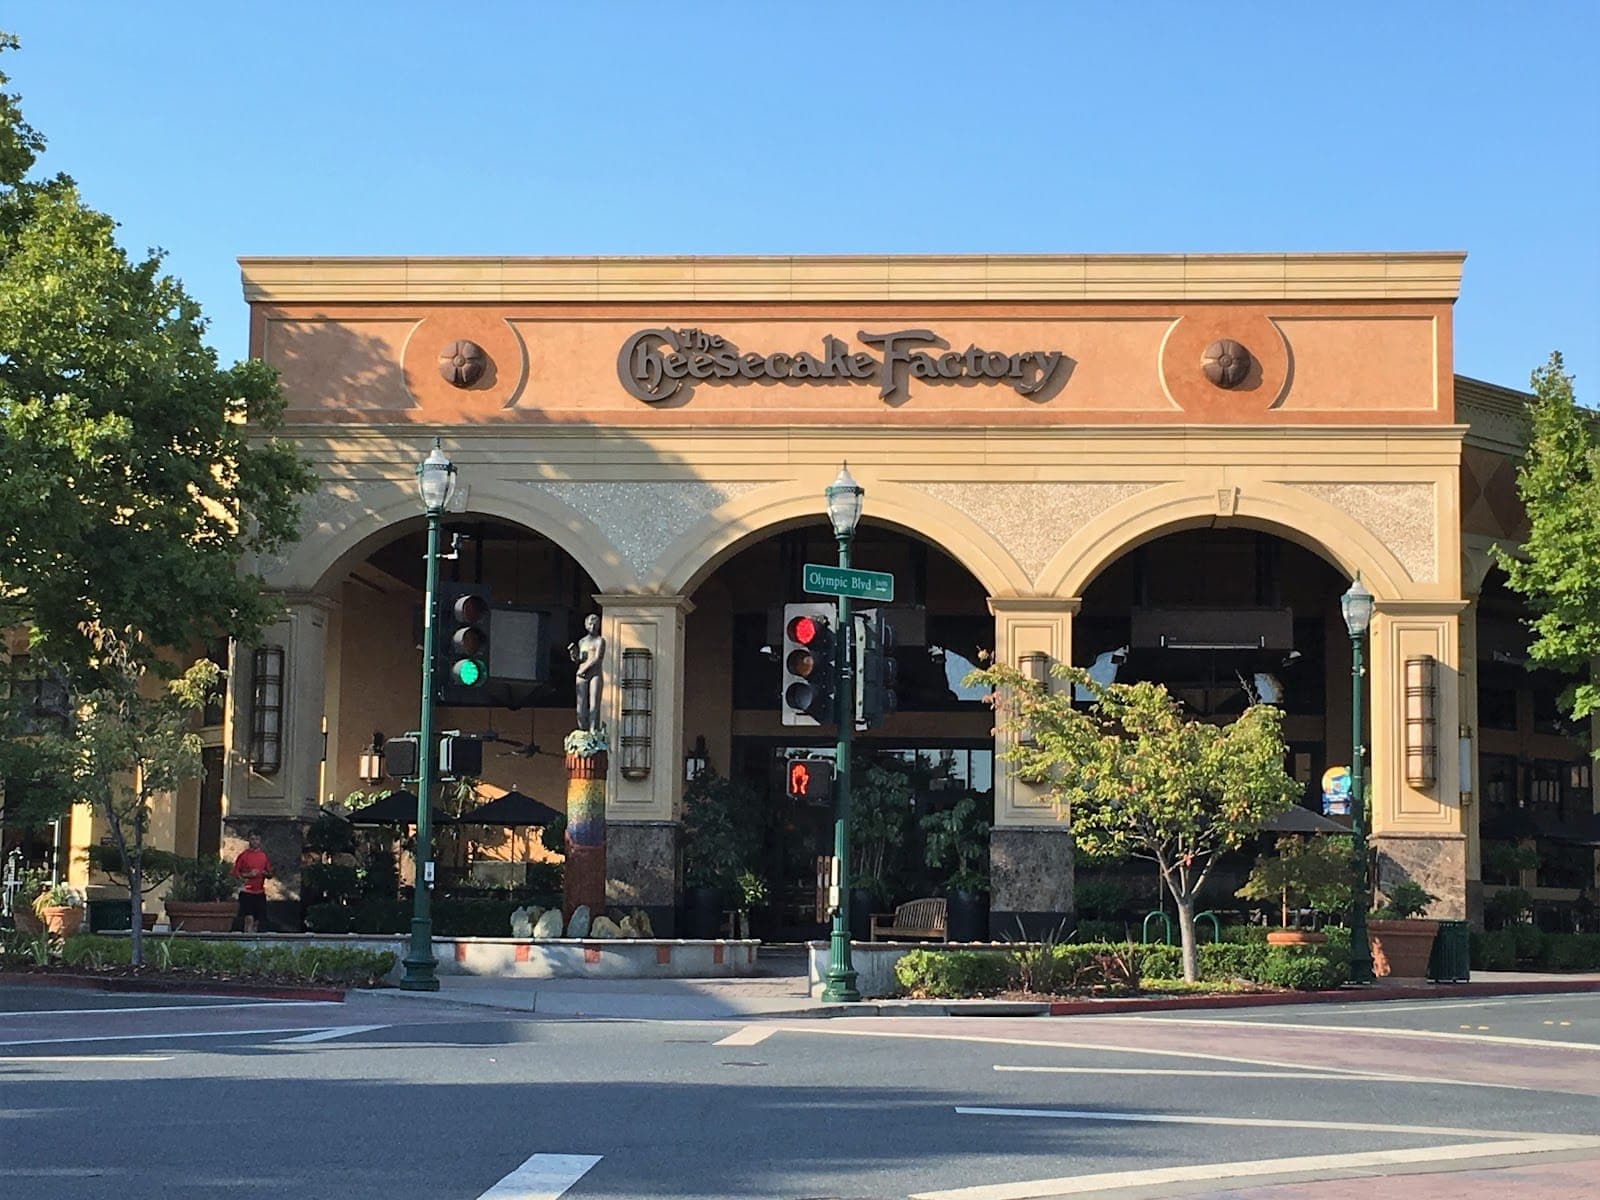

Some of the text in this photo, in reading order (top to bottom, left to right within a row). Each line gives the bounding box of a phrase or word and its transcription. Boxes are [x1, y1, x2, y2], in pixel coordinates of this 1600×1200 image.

[680, 327, 723, 352] The
[617, 326, 1062, 401] Cheesecake Factory
[809, 572, 848, 590] Olympic
[851, 577, 871, 590] Blvd
